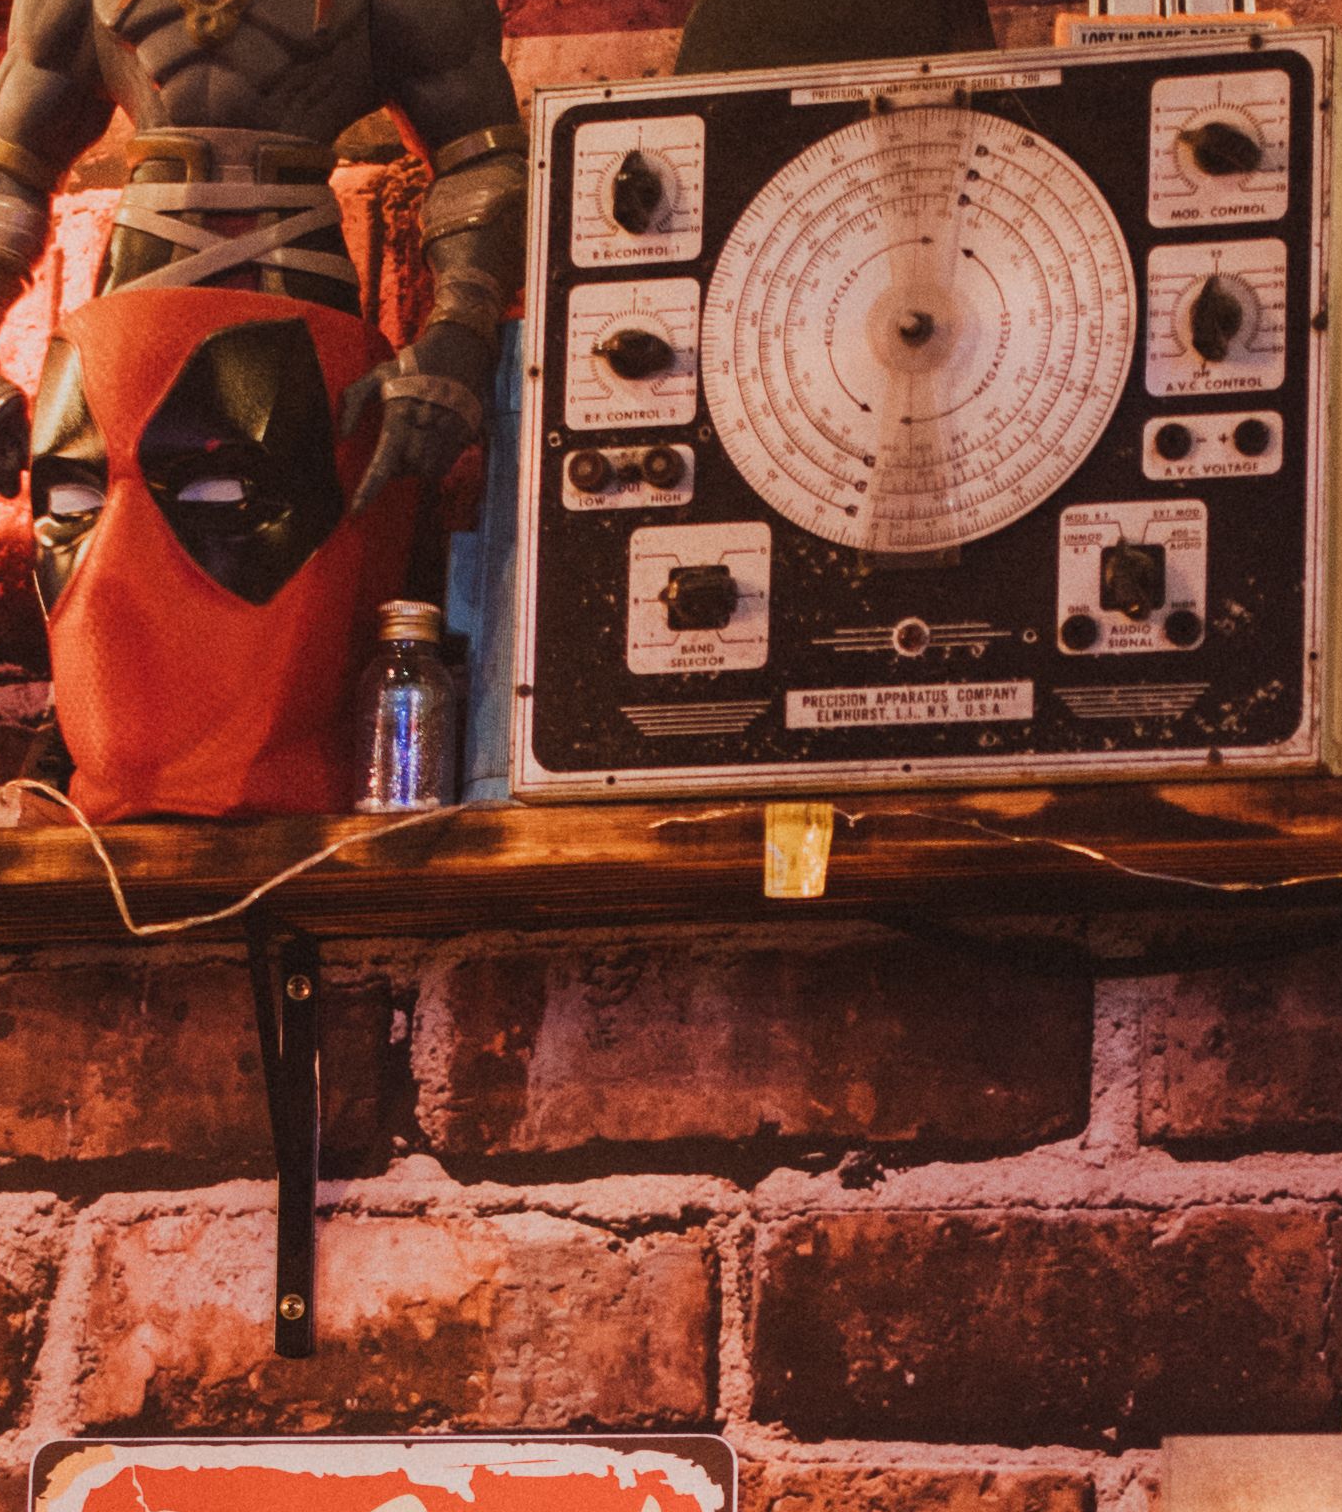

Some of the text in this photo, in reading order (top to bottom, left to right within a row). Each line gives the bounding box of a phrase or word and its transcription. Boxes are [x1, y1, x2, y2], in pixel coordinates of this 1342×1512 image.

[1210, 203, 1266, 217] CONTROL
[1205, 377, 1263, 390] CONTROL
[606, 410, 660, 422] CONTROL
[1202, 463, 1259, 475] VOLTAGE
[579, 493, 682, 507] LOW HIGH
[1110, 624, 1152, 635] AUDIO
[1109, 637, 1154, 648] SIGNAL
[681, 644, 715, 655] BAND
[671, 656, 725, 668] SELECTOR
[802, 686, 1019, 709] PRECISION APPARATUS COMPANY
